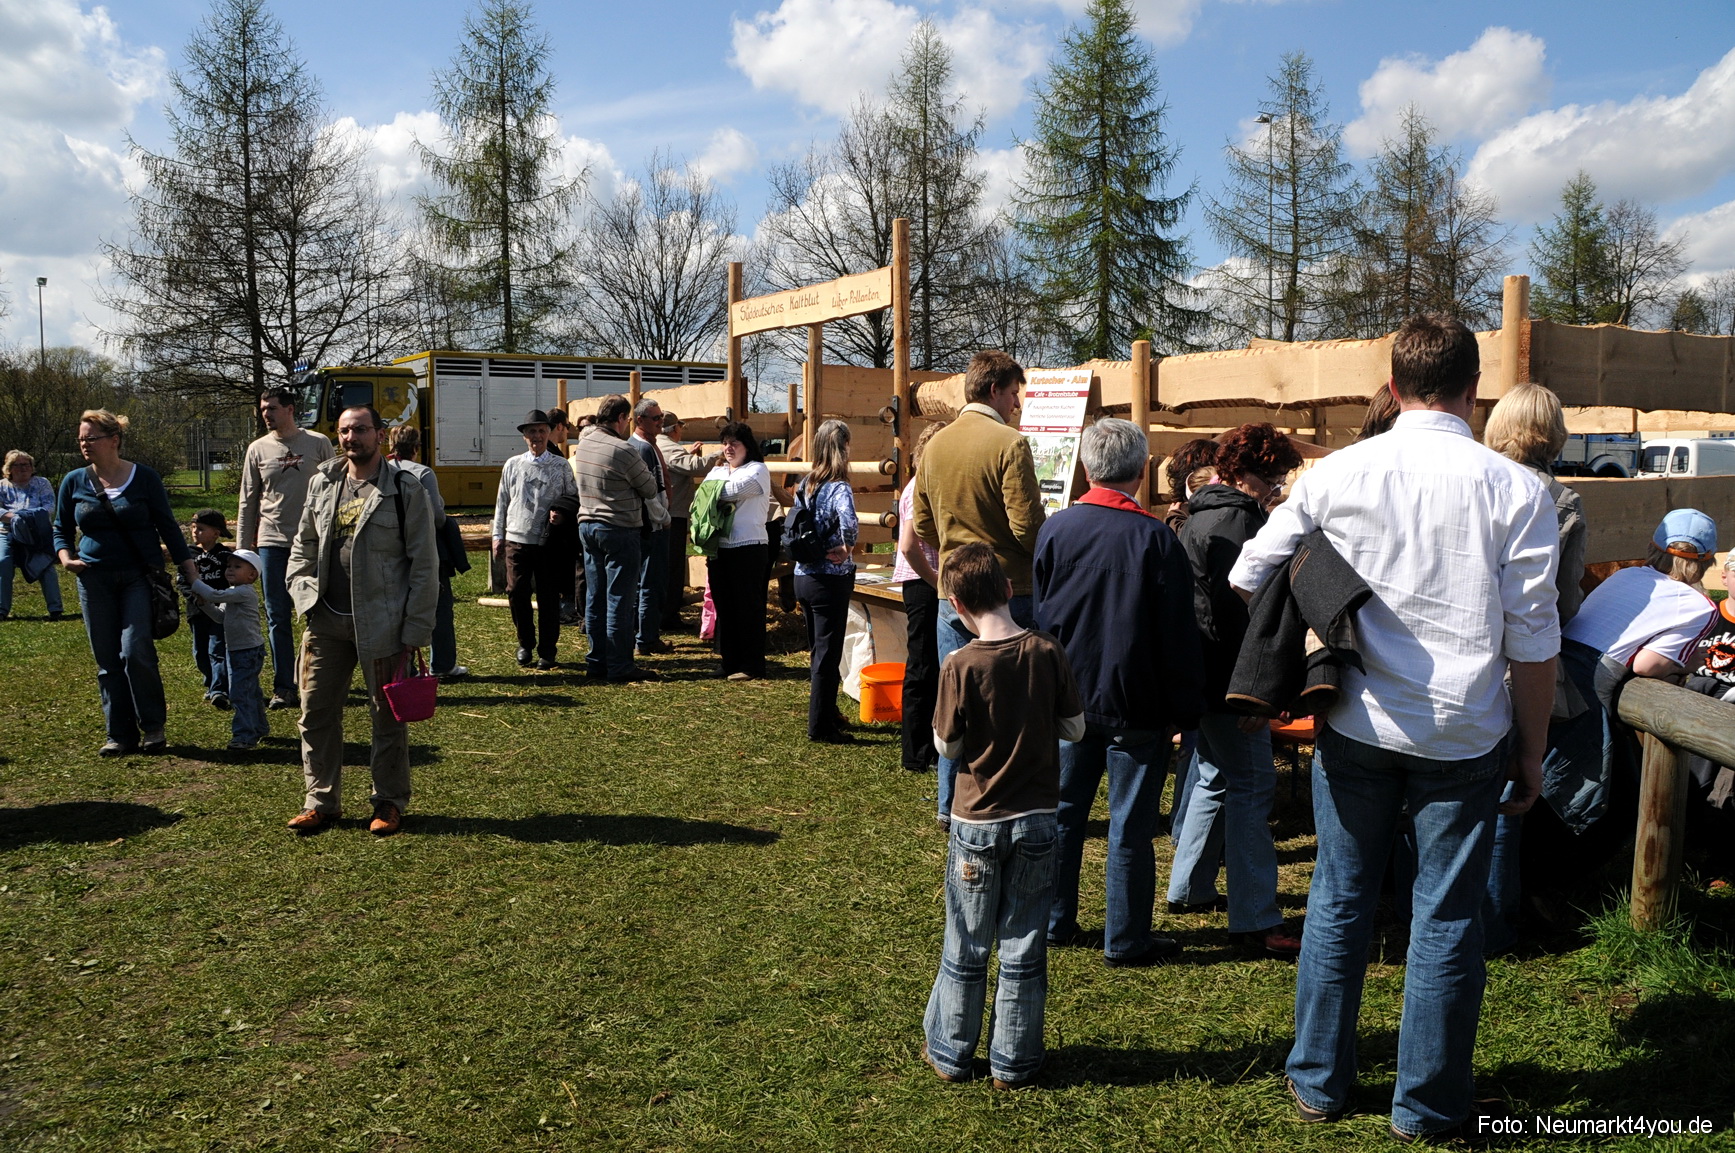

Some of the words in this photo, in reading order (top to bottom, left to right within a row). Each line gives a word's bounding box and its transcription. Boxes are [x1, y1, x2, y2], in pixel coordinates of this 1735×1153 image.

[789, 292, 819, 310] Kaltblut
[1030, 376, 1065, 385] Kutscher
[1070, 375, 1088, 384] Alm
